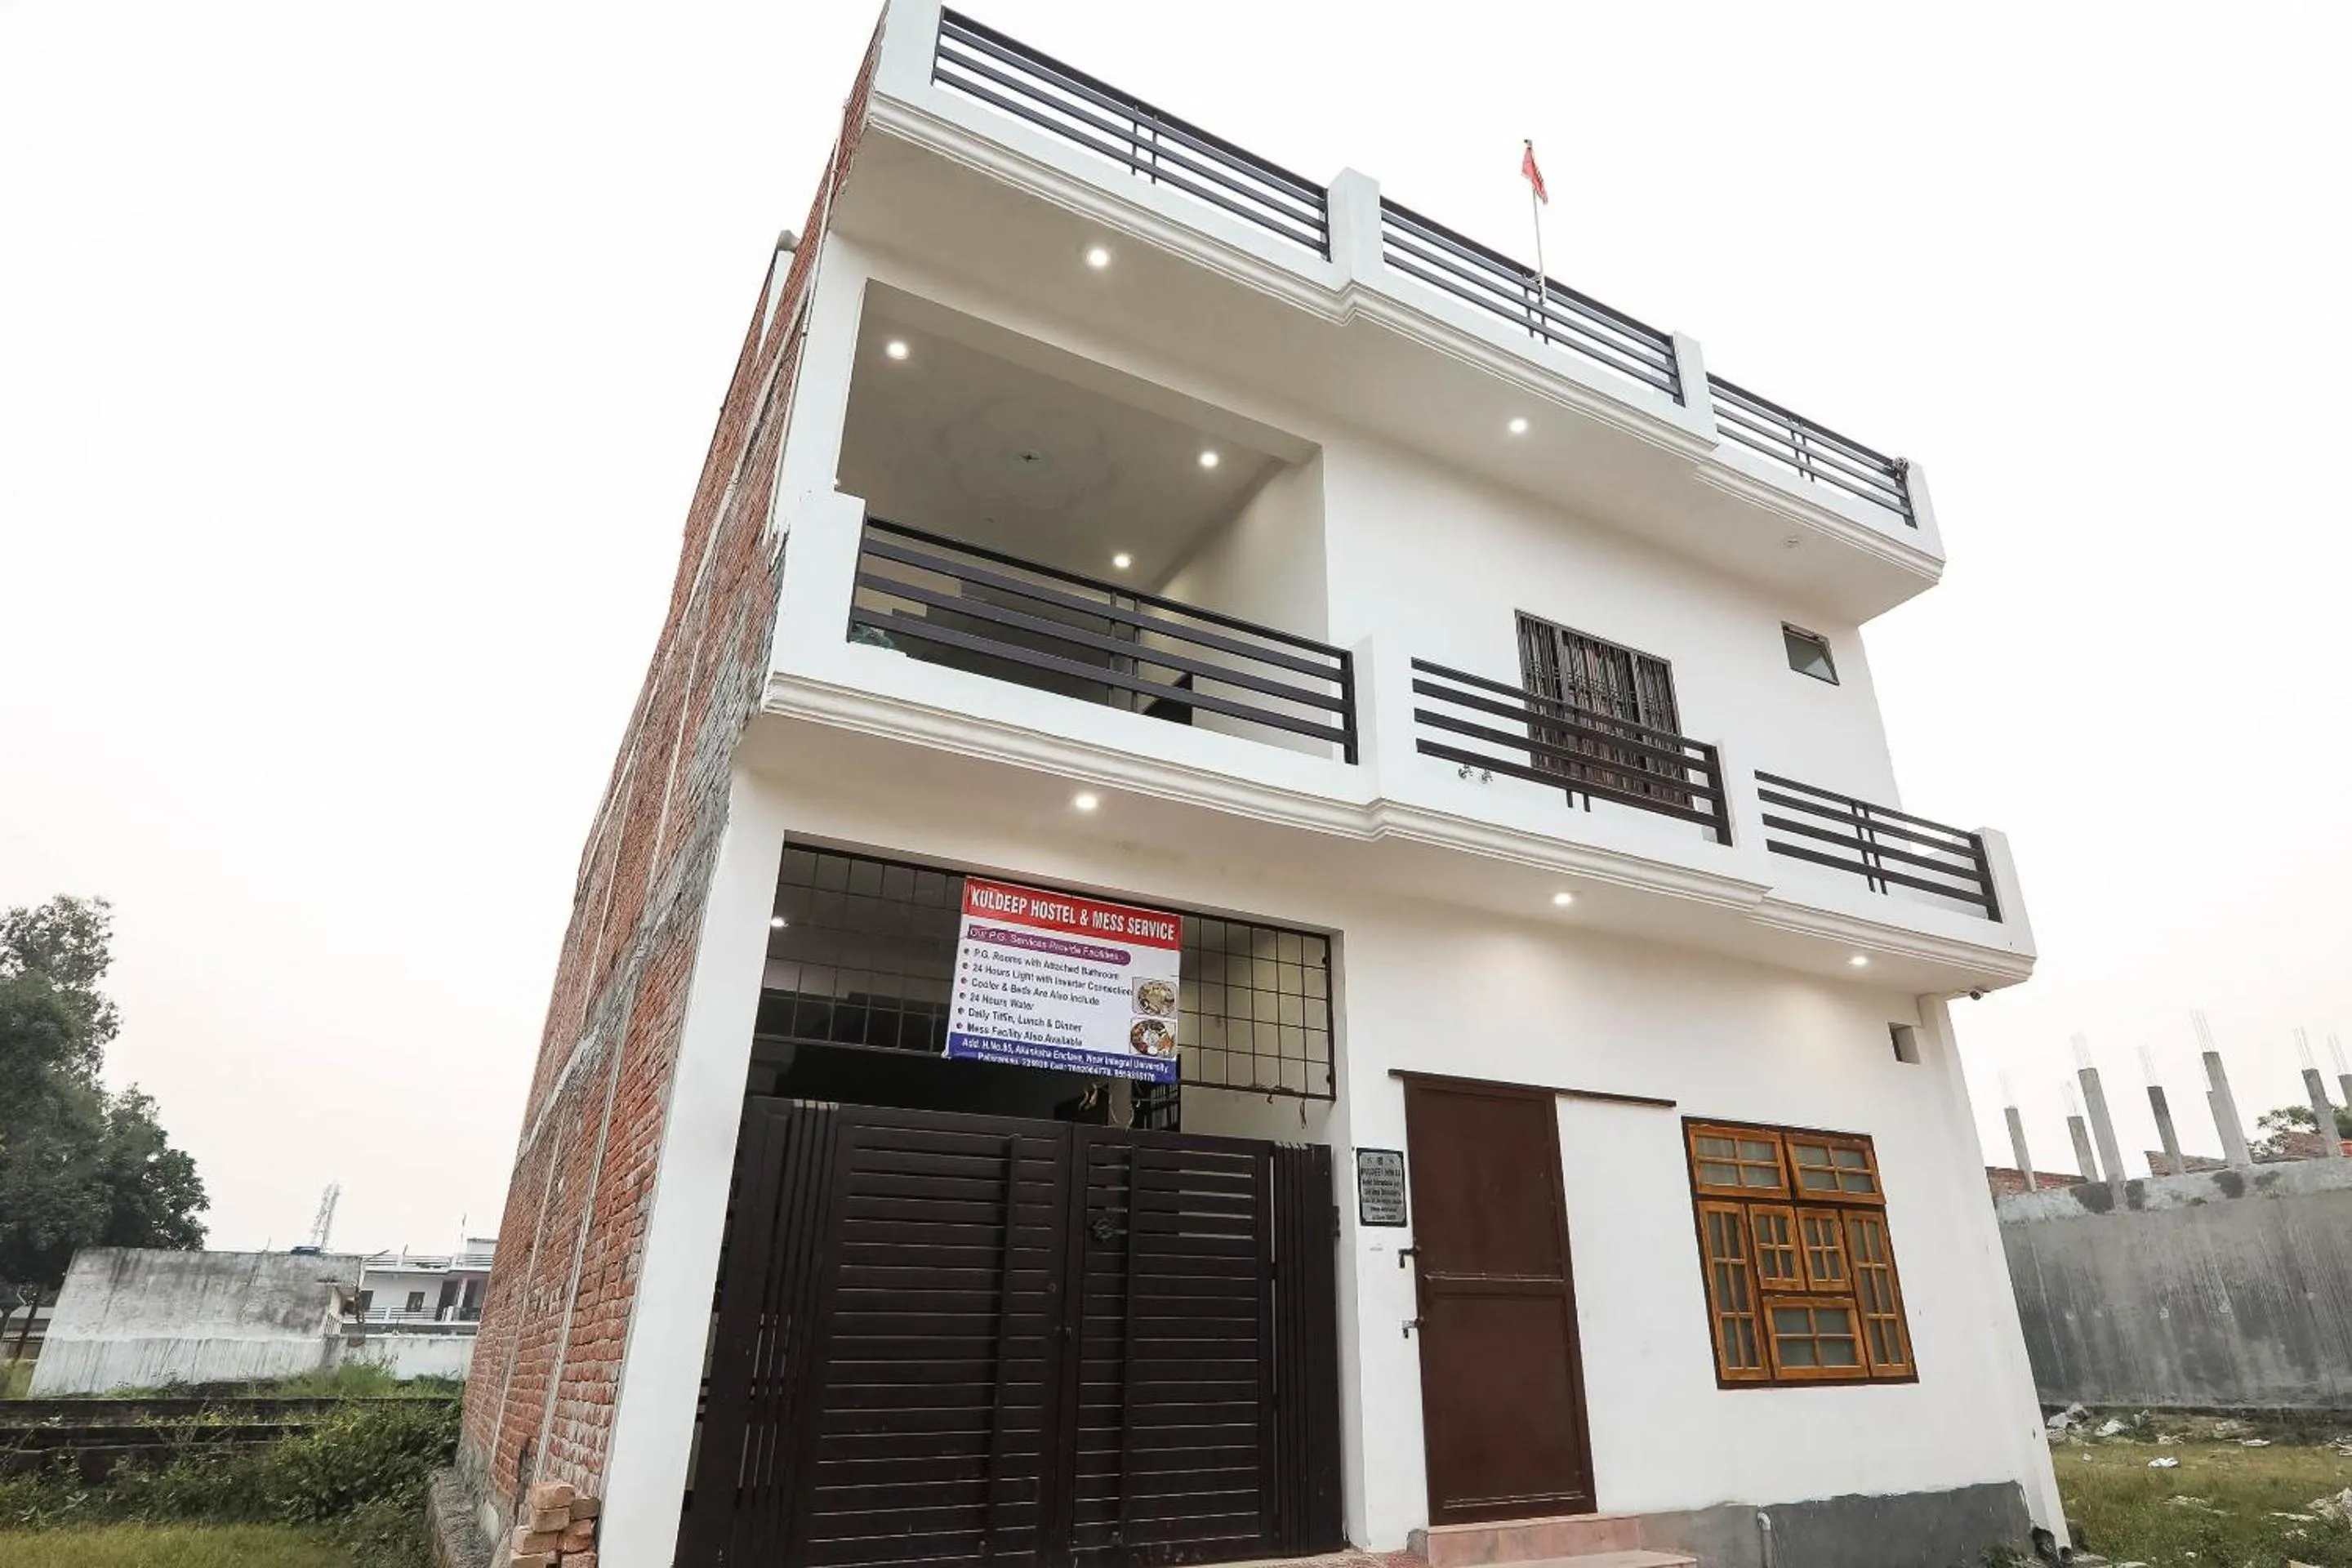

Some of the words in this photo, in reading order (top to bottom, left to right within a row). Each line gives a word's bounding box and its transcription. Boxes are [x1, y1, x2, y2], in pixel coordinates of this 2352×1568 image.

[971, 889, 1027, 915] KULDEEP
[1031, 900, 1076, 924] HOSTEL
[1080, 909, 1089, 925] &
[1093, 912, 1124, 932] MESS
[1127, 916, 1175, 941] SERVICE
[1011, 934, 1046, 949] Services
[973, 964, 982, 973] 24
[986, 966, 1010, 978] Hours
[1013, 970, 1034, 982] Light
[1036, 973, 1054, 984] with
[1055, 978, 1085, 990] Inverter
[992, 951, 1022, 965] Rooms
[1025, 958, 1041, 968] with
[1044, 960, 1079, 974] Attached
[1081, 967, 1119, 980] Bathroom
[969, 993, 980, 1002] 24
[982, 995, 1007, 1007] Hours
[1010, 998, 1034, 1010] Water
[972, 978, 1000, 991] Cooler
[1002, 982, 1009, 991] &
[1011, 985, 1031, 995] Beds
[1033, 988, 1048, 998] Are
[1049, 991, 1068, 1002] Also
[1071, 994, 1100, 1006] Include
[969, 1008, 990, 1021] Daily
[1018, 1015, 1045, 1027] Lunch
[1047, 1020, 1053, 1028] &
[1054, 1021, 1083, 1033] Dinner
[967, 1022, 989, 1035] Mess
[992, 1026, 1022, 1040] Facility
[1023, 1031, 1043, 1041] Also
[1045, 1033, 1082, 1046] Available
[1086, 1054, 1103, 1064] Near
[1105, 1055, 1132, 1068] Integral
